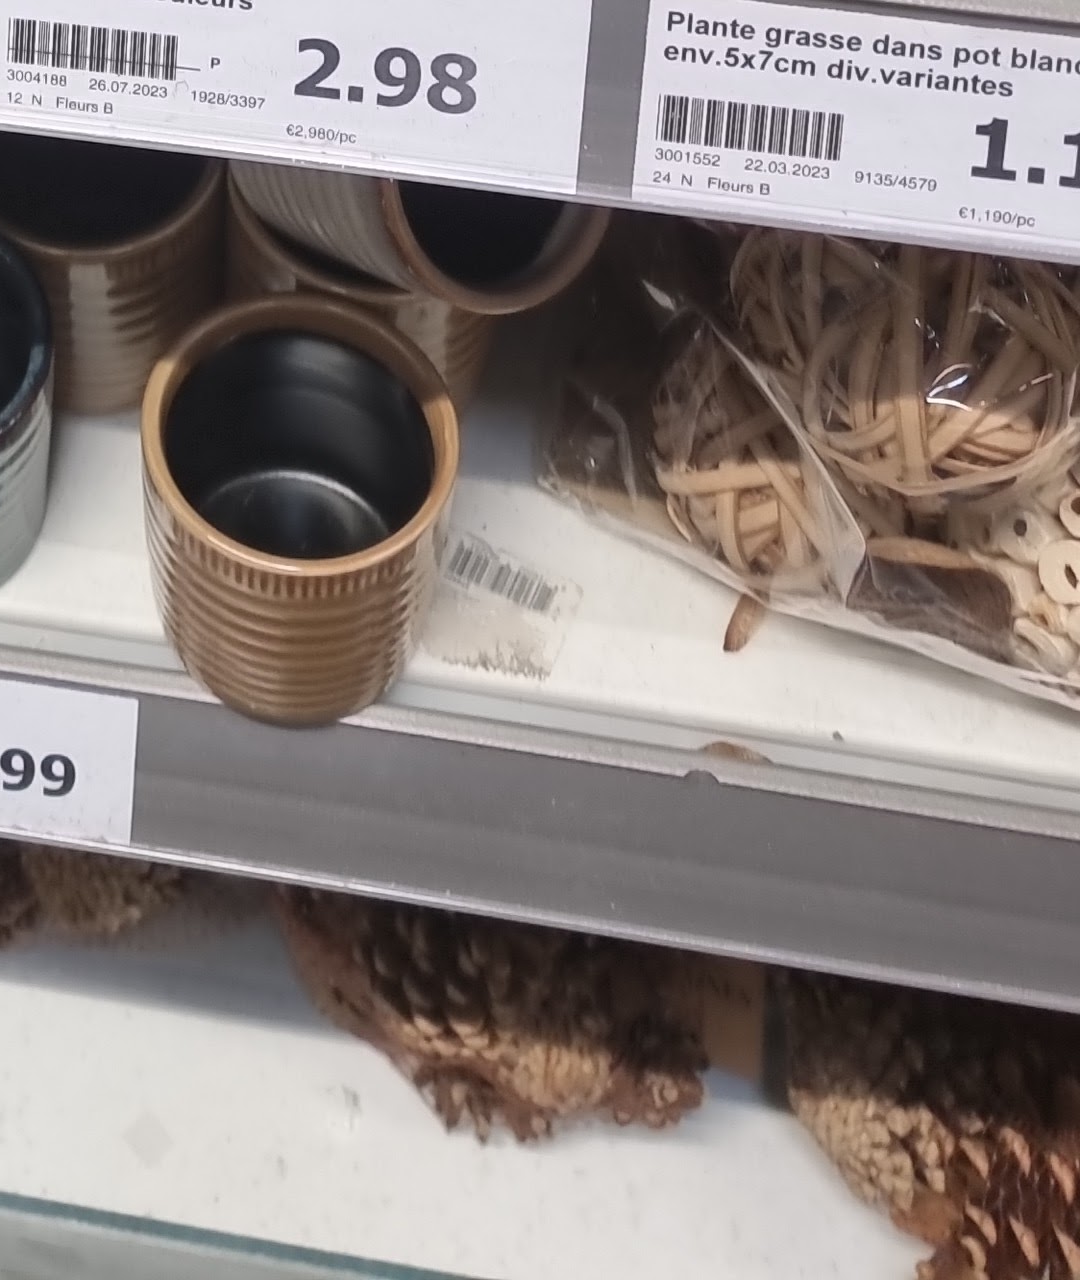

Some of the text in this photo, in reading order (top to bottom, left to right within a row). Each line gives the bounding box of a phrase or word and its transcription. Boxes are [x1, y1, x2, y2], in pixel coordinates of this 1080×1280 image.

[667, 11, 755, 40] Plante
[765, 27, 862, 52] grasse
[872, 34, 942, 60] dans
[953, 47, 1001, 68] pot
[211, 57, 220, 69] P
[294, 38, 477, 114] 2.98
[664, 45, 1013, 97] env.5x7cm div.variantes
[7, 69, 265, 109] 3004188 26.07.2023 1928/3397
[7, 92, 113, 114] 12 N Fleurs B
[286, 124, 356, 145] €2,980/pc
[655, 148, 720, 167] 3001552
[744, 158, 830, 179] 22.03.2023
[653, 171, 770, 195] 24 N Fleurs B
[959, 207, 1035, 228] €1,190/pc
